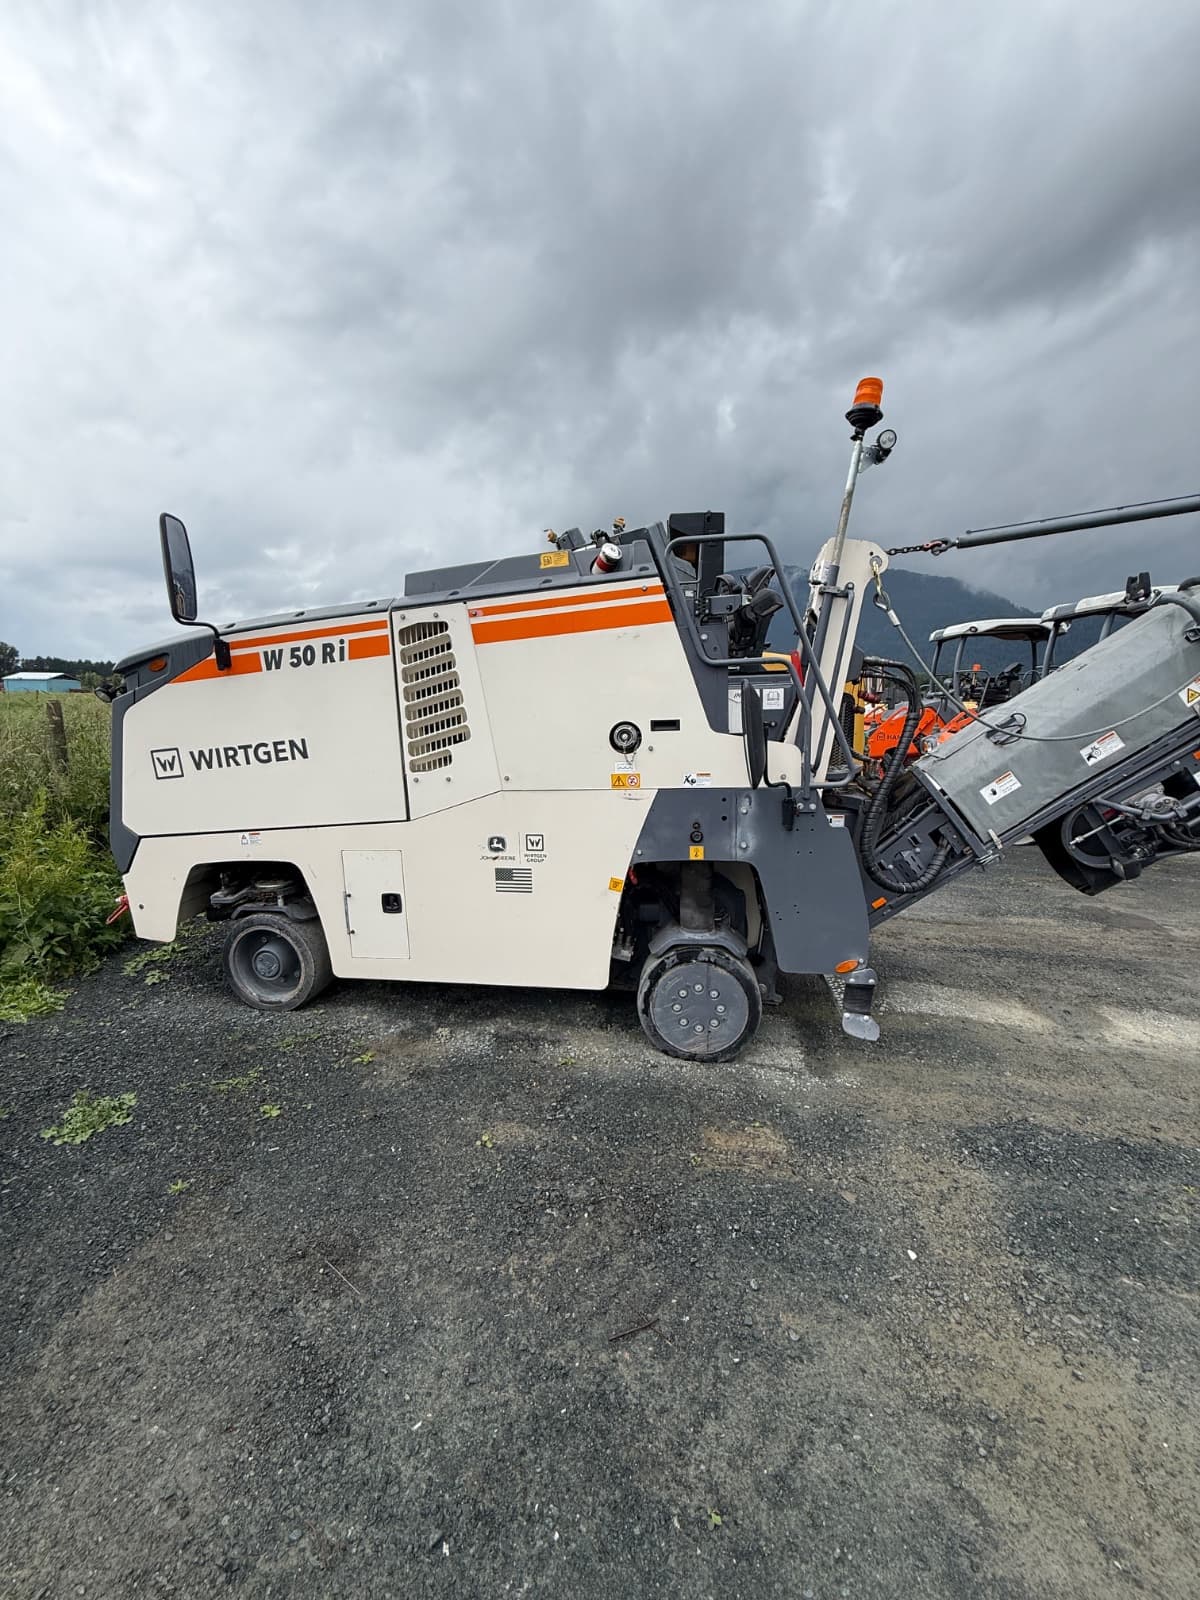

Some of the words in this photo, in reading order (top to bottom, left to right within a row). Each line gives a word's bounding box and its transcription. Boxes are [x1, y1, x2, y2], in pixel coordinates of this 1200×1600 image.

[263, 649, 283, 671] W
[290, 645, 315, 668] 50
[322, 639, 345, 664] Ri
[189, 738, 309, 771] WIRTGEN
